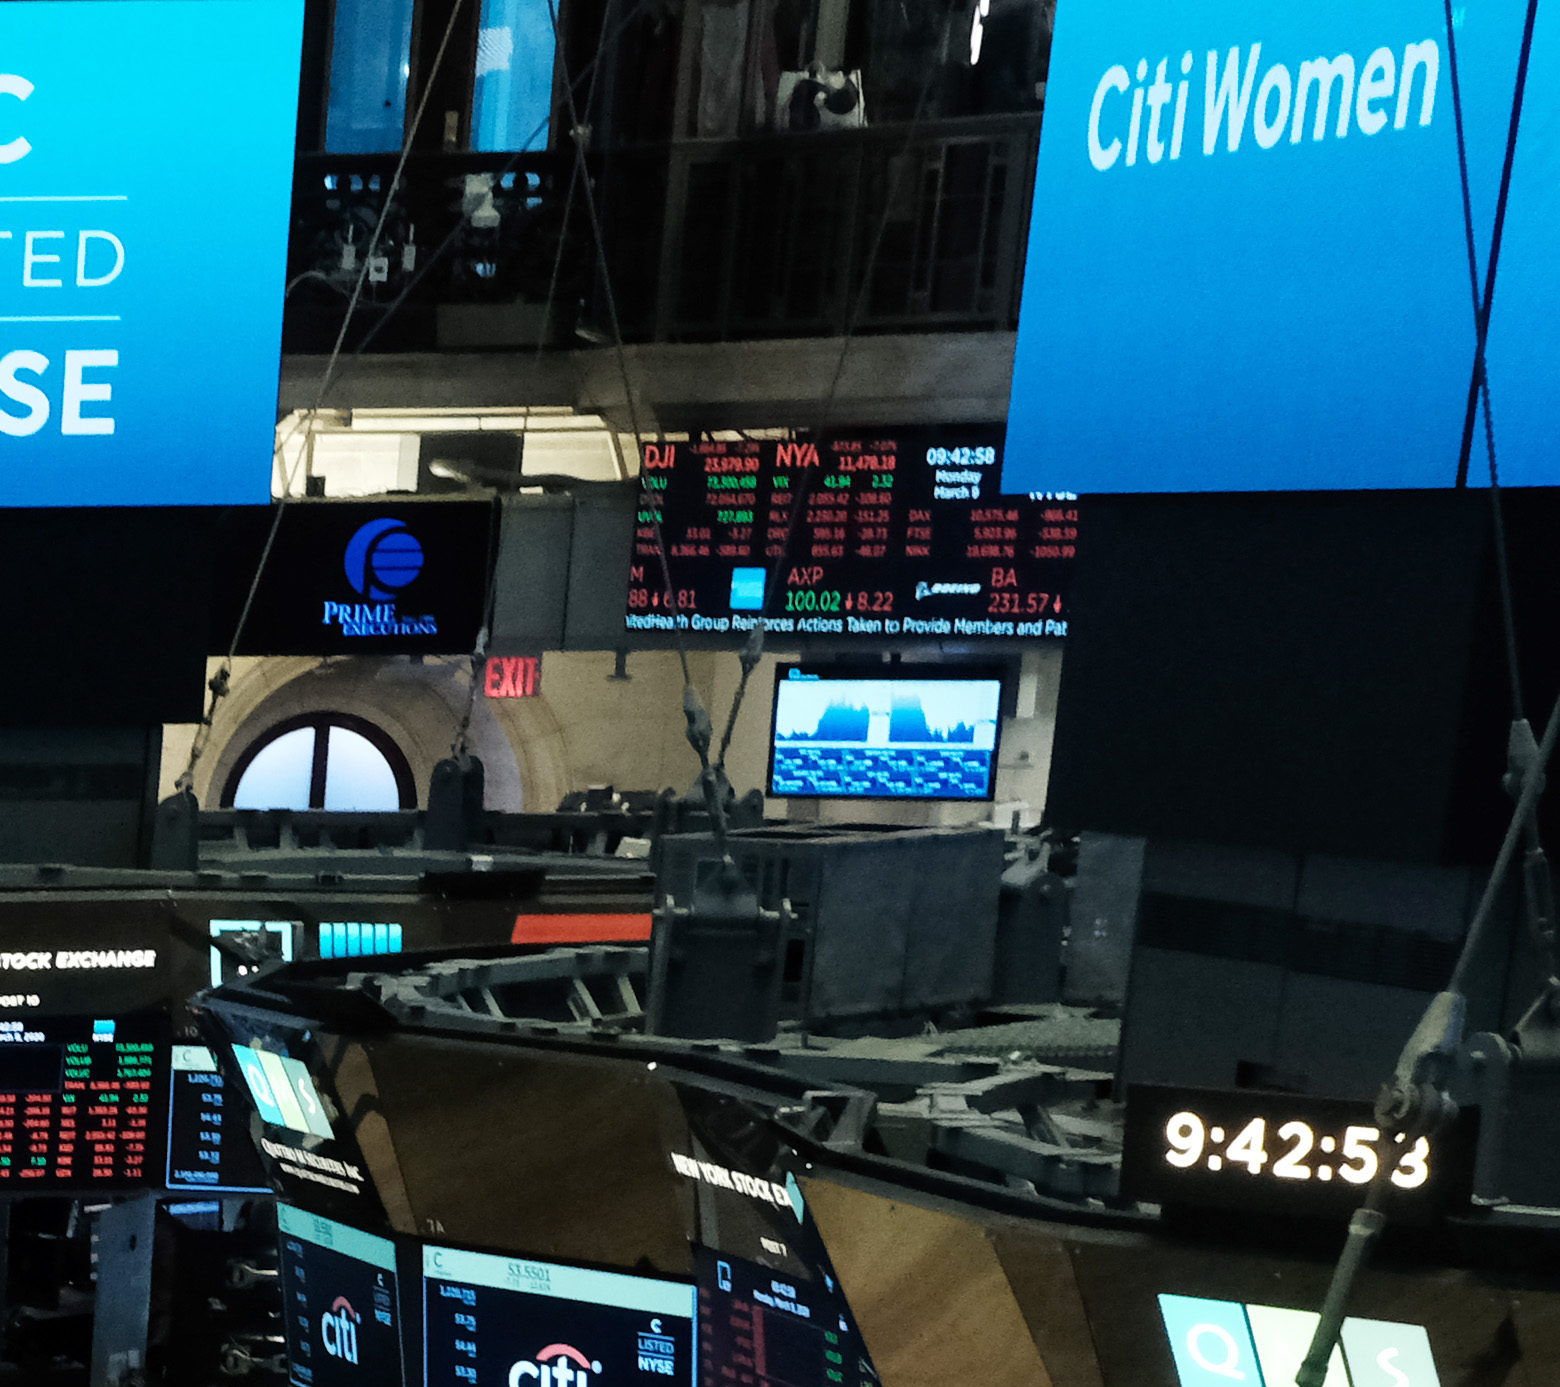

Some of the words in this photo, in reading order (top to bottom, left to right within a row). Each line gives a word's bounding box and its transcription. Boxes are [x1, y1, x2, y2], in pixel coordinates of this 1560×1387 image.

[1087, 44, 1188, 170] Citi
[1199, 37, 1440, 156] Women
[926, 447, 996, 467] 09:42:58
[787, 567, 824, 585] AXP
[991, 567, 1018, 588] BA
[785, 591, 841, 612] 100.02
[987, 593, 1050, 614] 231.57
[321, 601, 396, 626] PRIME
[342, 621, 437, 638] EXECUTIONS
[484, 657, 540, 698] EXIT
[56, 950, 156, 969] EXCHANGE
[637, 1339, 673, 1354] LISTED
[637, 1357, 674, 1375] NYSE
